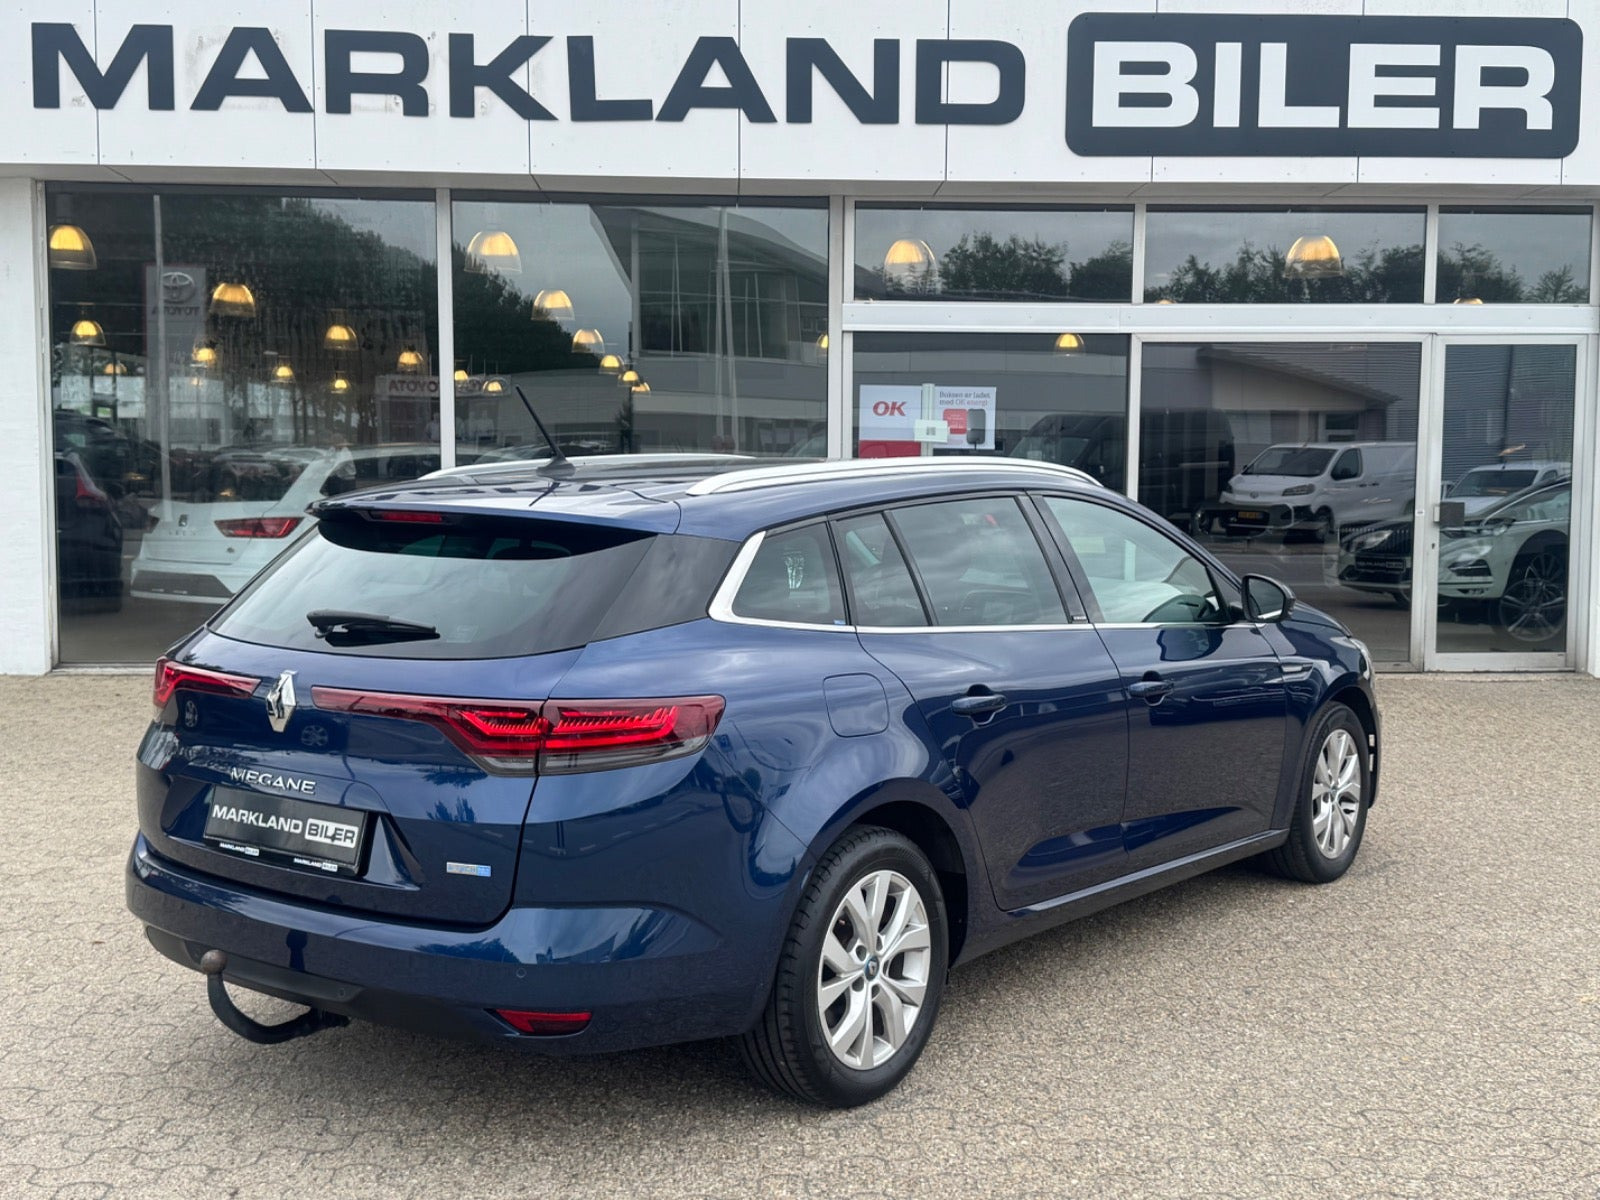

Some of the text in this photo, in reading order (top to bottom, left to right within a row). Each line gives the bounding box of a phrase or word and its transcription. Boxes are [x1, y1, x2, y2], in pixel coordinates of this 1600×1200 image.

[31, 22, 1556, 130] MARKLAND BILER
[872, 401, 906, 416] OK
[231, 767, 316, 795] MEGANE
[212, 804, 356, 845] MARKLAND BILER
